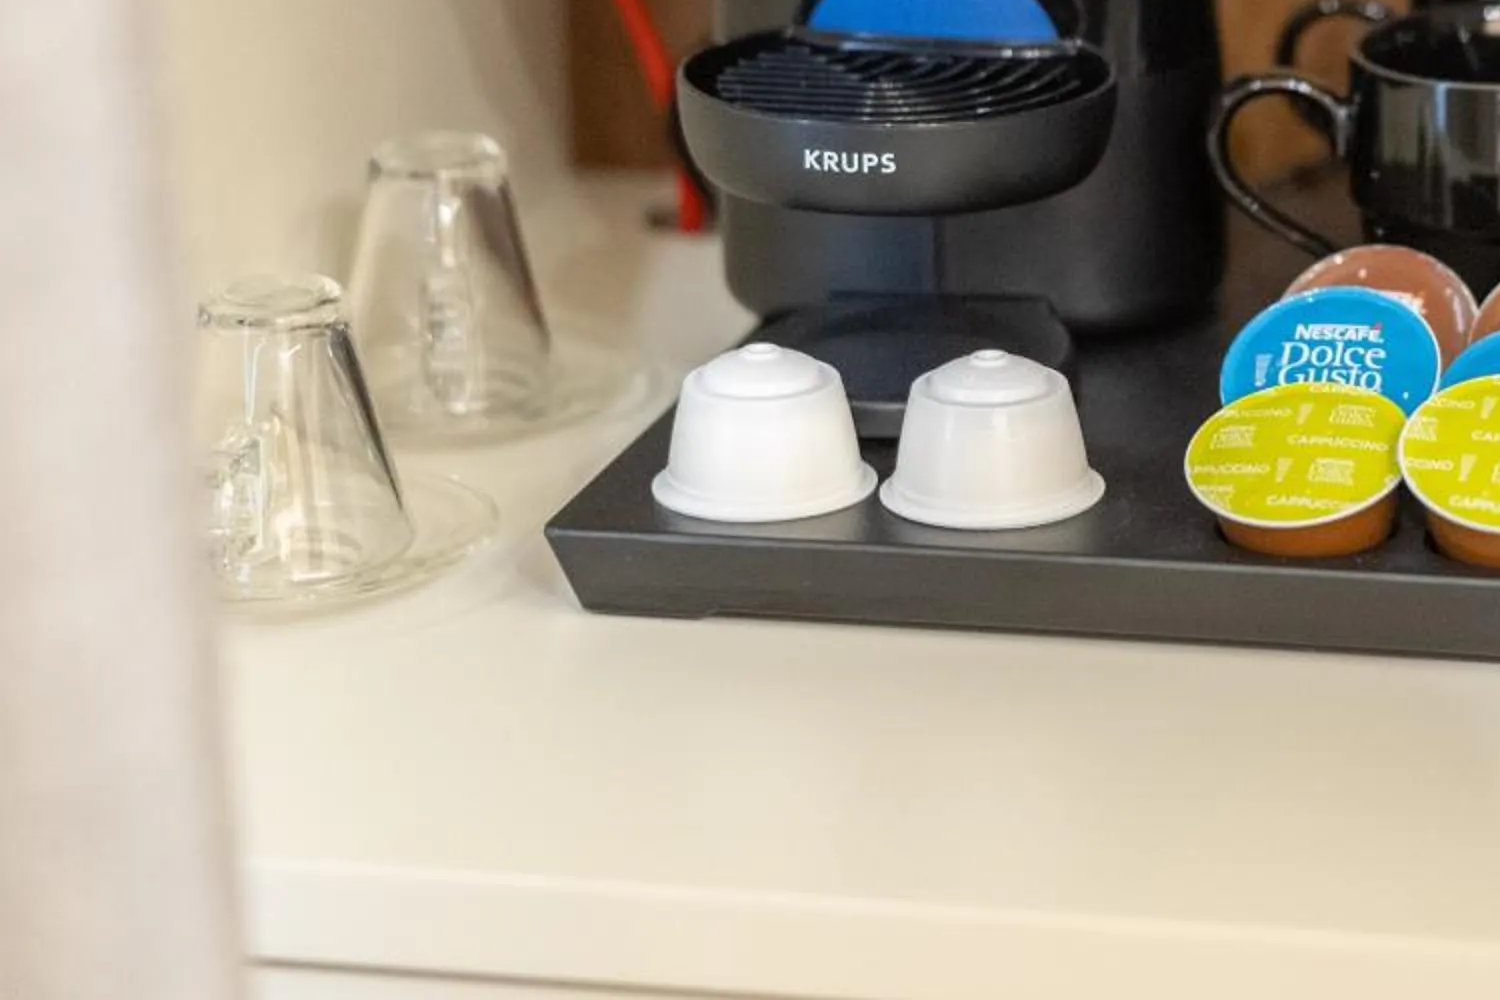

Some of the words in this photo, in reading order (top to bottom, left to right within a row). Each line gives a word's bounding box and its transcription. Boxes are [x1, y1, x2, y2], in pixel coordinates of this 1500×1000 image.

[804, 149, 897, 174] KRUPS
[1279, 342, 1387, 368] Dolce
[1278, 366, 1382, 392] Gusto
